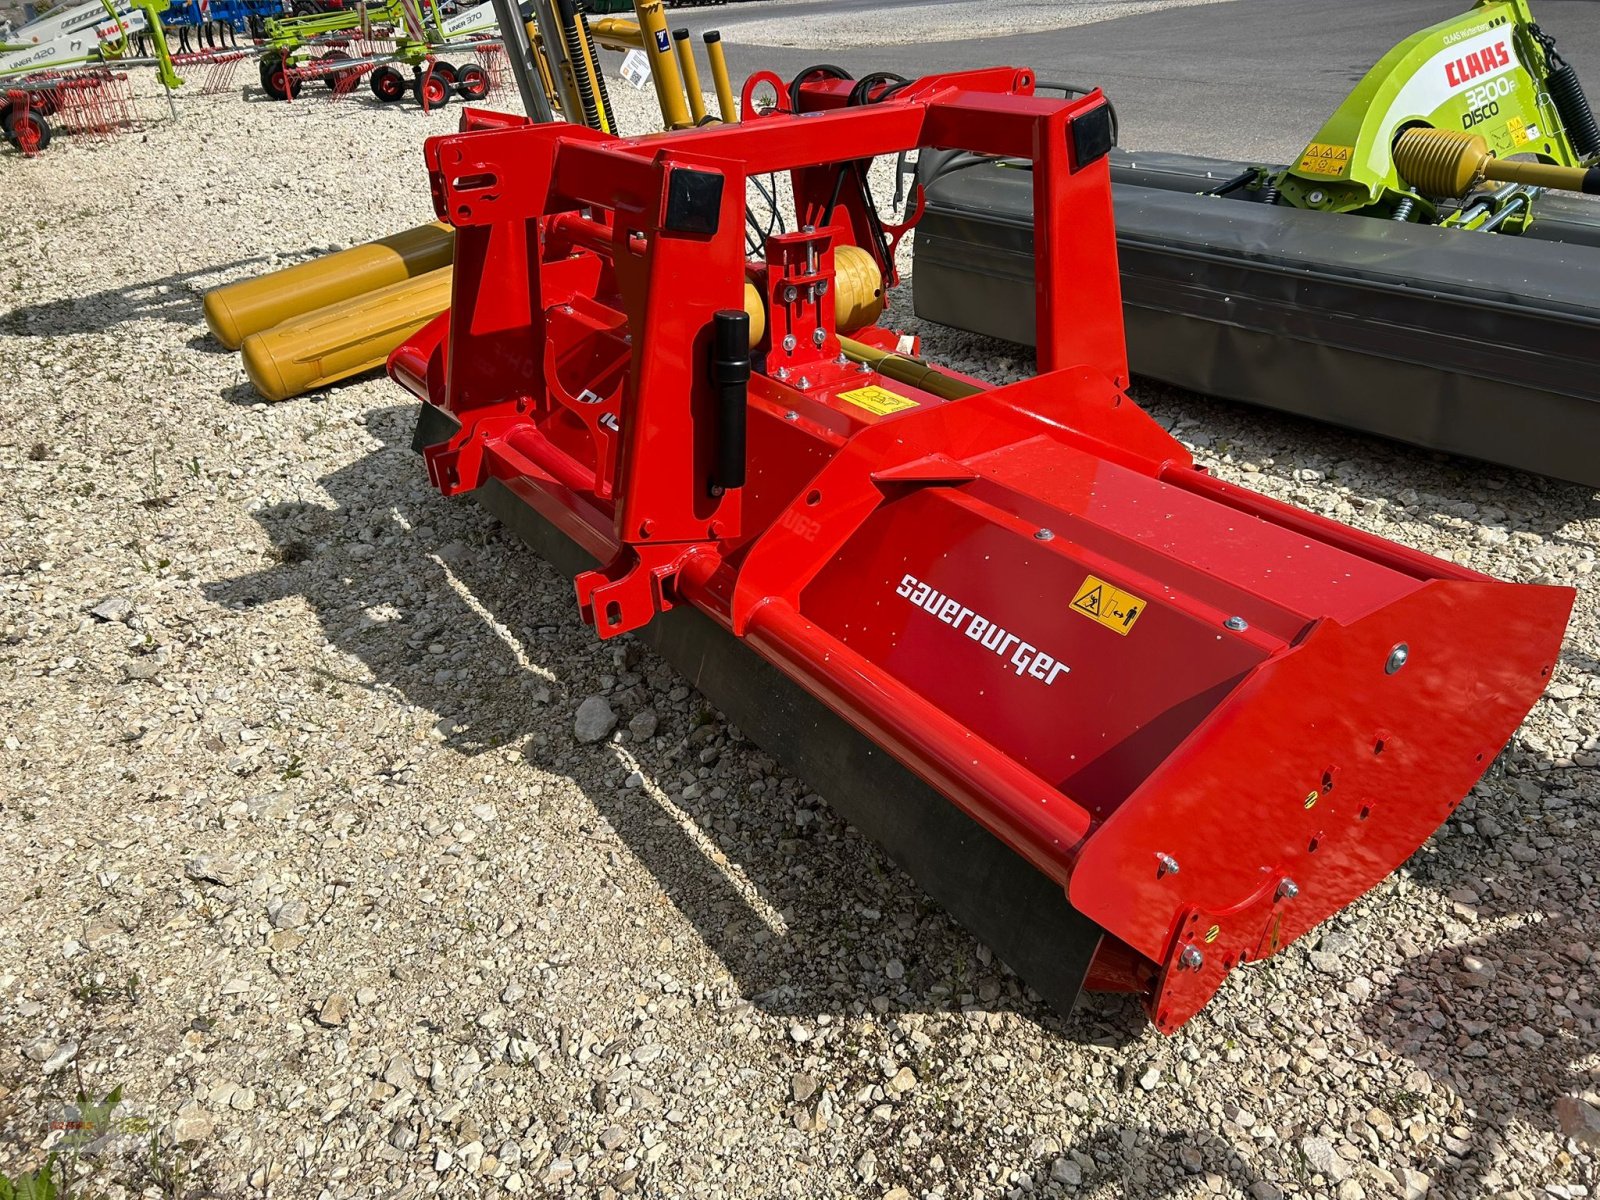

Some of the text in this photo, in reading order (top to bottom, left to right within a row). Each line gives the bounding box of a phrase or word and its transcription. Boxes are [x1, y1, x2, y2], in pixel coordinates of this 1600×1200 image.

[466, 11, 482, 25] 370
[33, 46, 56, 60] 420
[1445, 41, 1509, 88] CLAAS
[1462, 101, 1499, 130] DISCO
